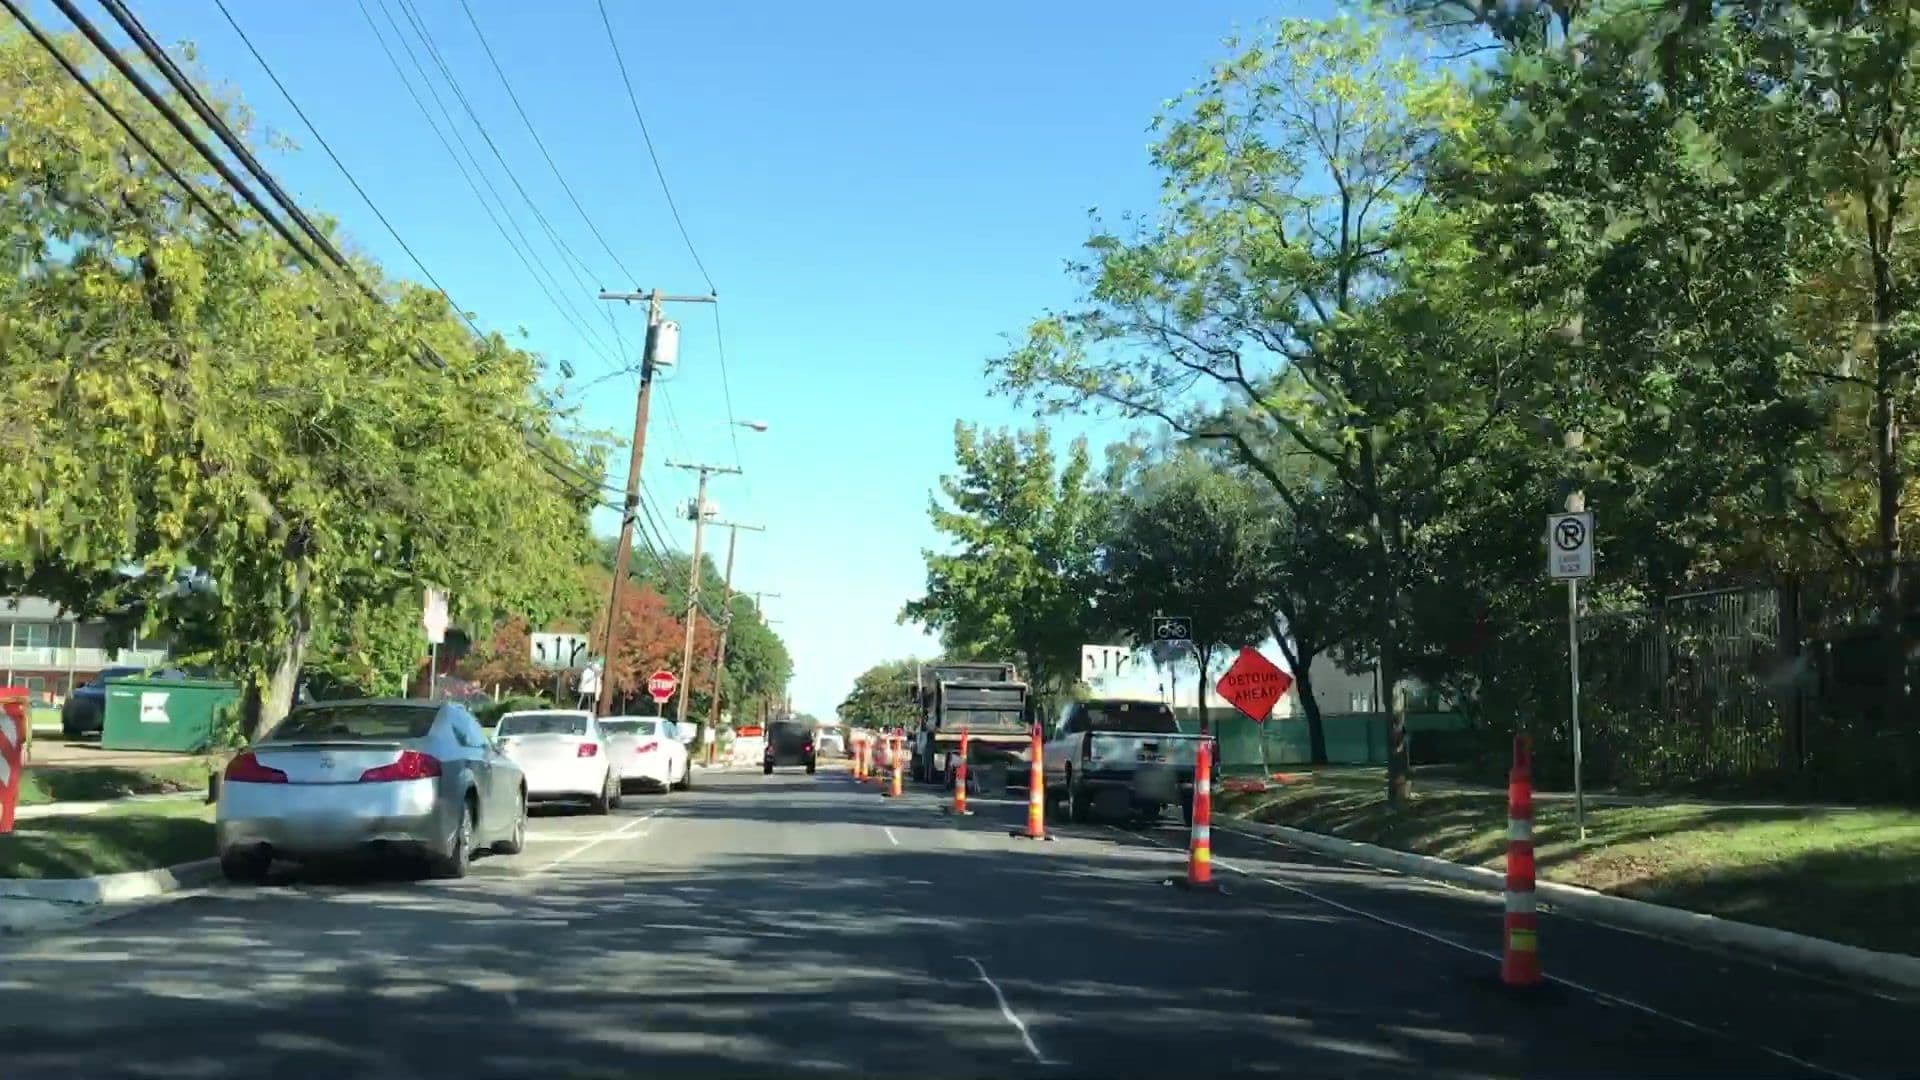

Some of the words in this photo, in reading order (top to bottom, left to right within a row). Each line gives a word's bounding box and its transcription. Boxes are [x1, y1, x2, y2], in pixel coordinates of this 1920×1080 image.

[650, 679, 674, 690] STOP
[1228, 671, 1278, 687] DETOUR
[1234, 686, 1278, 701] AHEAD
